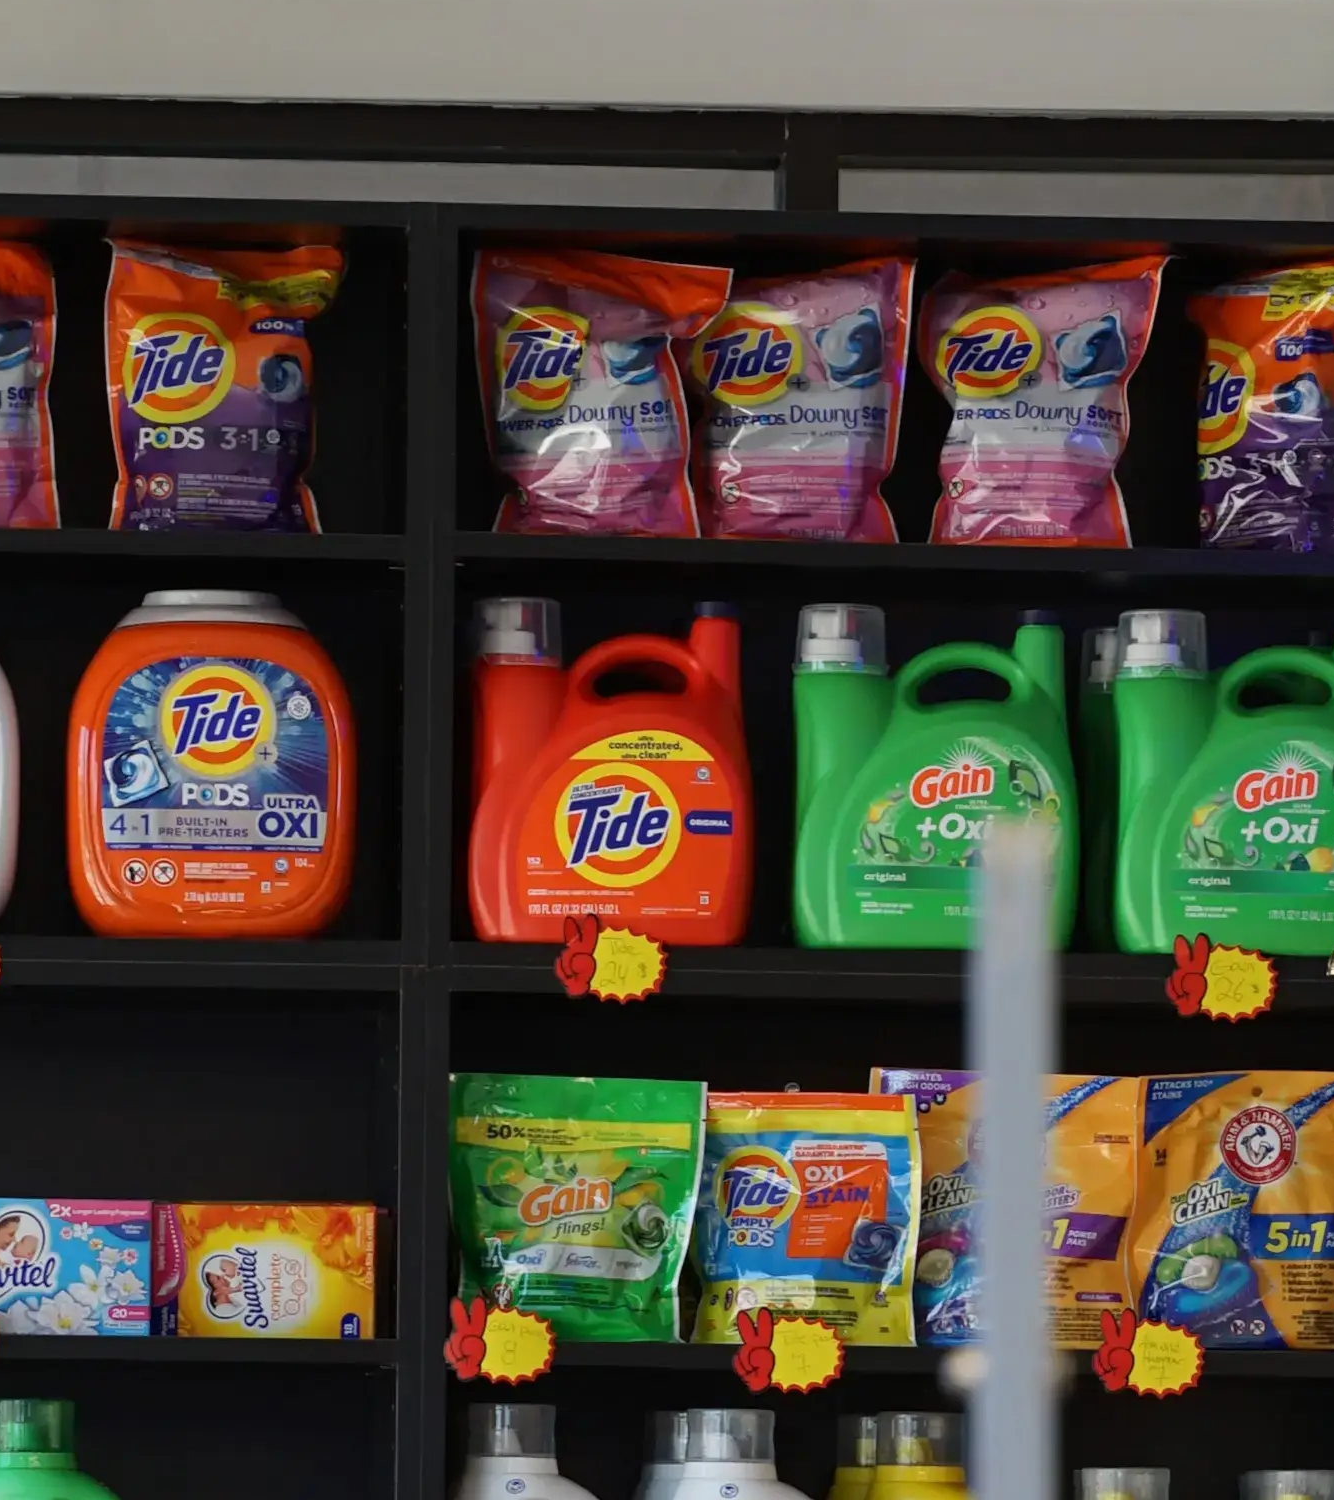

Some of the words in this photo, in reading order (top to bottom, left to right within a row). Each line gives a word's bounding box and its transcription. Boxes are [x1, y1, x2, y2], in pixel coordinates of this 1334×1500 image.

[703, 331, 792, 391] Tide
[946, 332, 1033, 384] Tide
[128, 333, 226, 408] Tide
[569, 404, 634, 427] Downy
[791, 405, 859, 428] Downy
[1015, 401, 1083, 425] Downy
[1086, 405, 1122, 422] SOFT
[139, 427, 205, 449] PODS
[172, 692, 261, 757] Tide
[609, 742, 683, 751] concentrated,
[182, 783, 249, 806] PODS
[911, 764, 995, 808] Gain
[1235, 769, 1319, 812] Gain
[267, 797, 315, 809] ULTRA
[110, 815, 126, 834] 4
[159, 827, 248, 838] PRE-TREATERS
[176, 817, 228, 826] BUILT-IN
[258, 812, 317, 838] OXI
[566, 792, 671, 868] Tide
[1241, 818, 1319, 844] +Oxi
[863, 871, 906, 883] original
[1188, 876, 1231, 887] original
[921, 1083, 951, 1091] ODORS
[1154, 1081, 1191, 1089] ATTACKS
[1225, 1122, 1238, 1151] ARM
[1240, 1113, 1249, 1126] &
[1254, 1111, 1291, 1151] HAMMER
[805, 1166, 843, 1181] OXI
[929, 1175, 968, 1192] OXI
[520, 1178, 613, 1225] Gain
[724, 1166, 792, 1217] Tide
[806, 1188, 870, 1204] STAIN
[1187, 1182, 1217, 1203] OXI
[1175, 1192, 1230, 1223] CLEAN
[554, 1217, 606, 1238] flings!
[731, 1218, 774, 1228] SIMPLY
[728, 1229, 775, 1247] PODS
[245, 1247, 268, 1328] Suavitel
[271, 1253, 281, 1320] complete
[112, 1308, 127, 1318] 20
